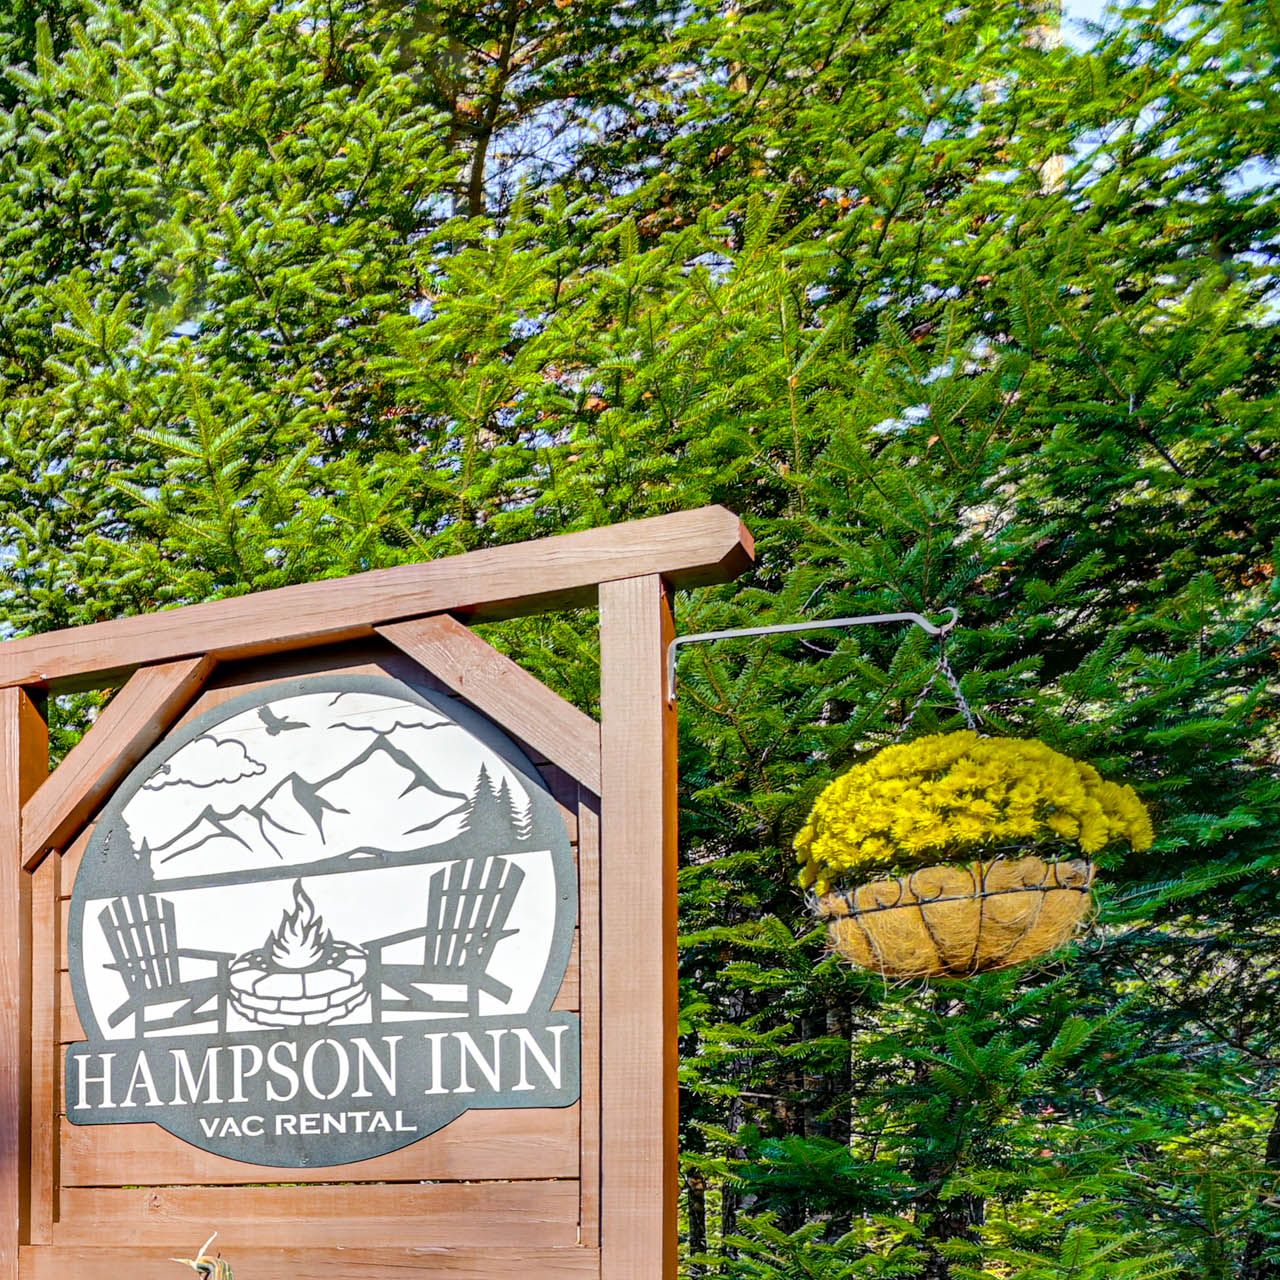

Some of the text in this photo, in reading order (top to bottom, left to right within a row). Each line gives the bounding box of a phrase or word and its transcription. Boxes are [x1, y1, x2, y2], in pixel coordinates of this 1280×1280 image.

[73, 1025, 569, 1110] HAMPSON INN
[199, 1111, 418, 1138] VAC RENTAL
